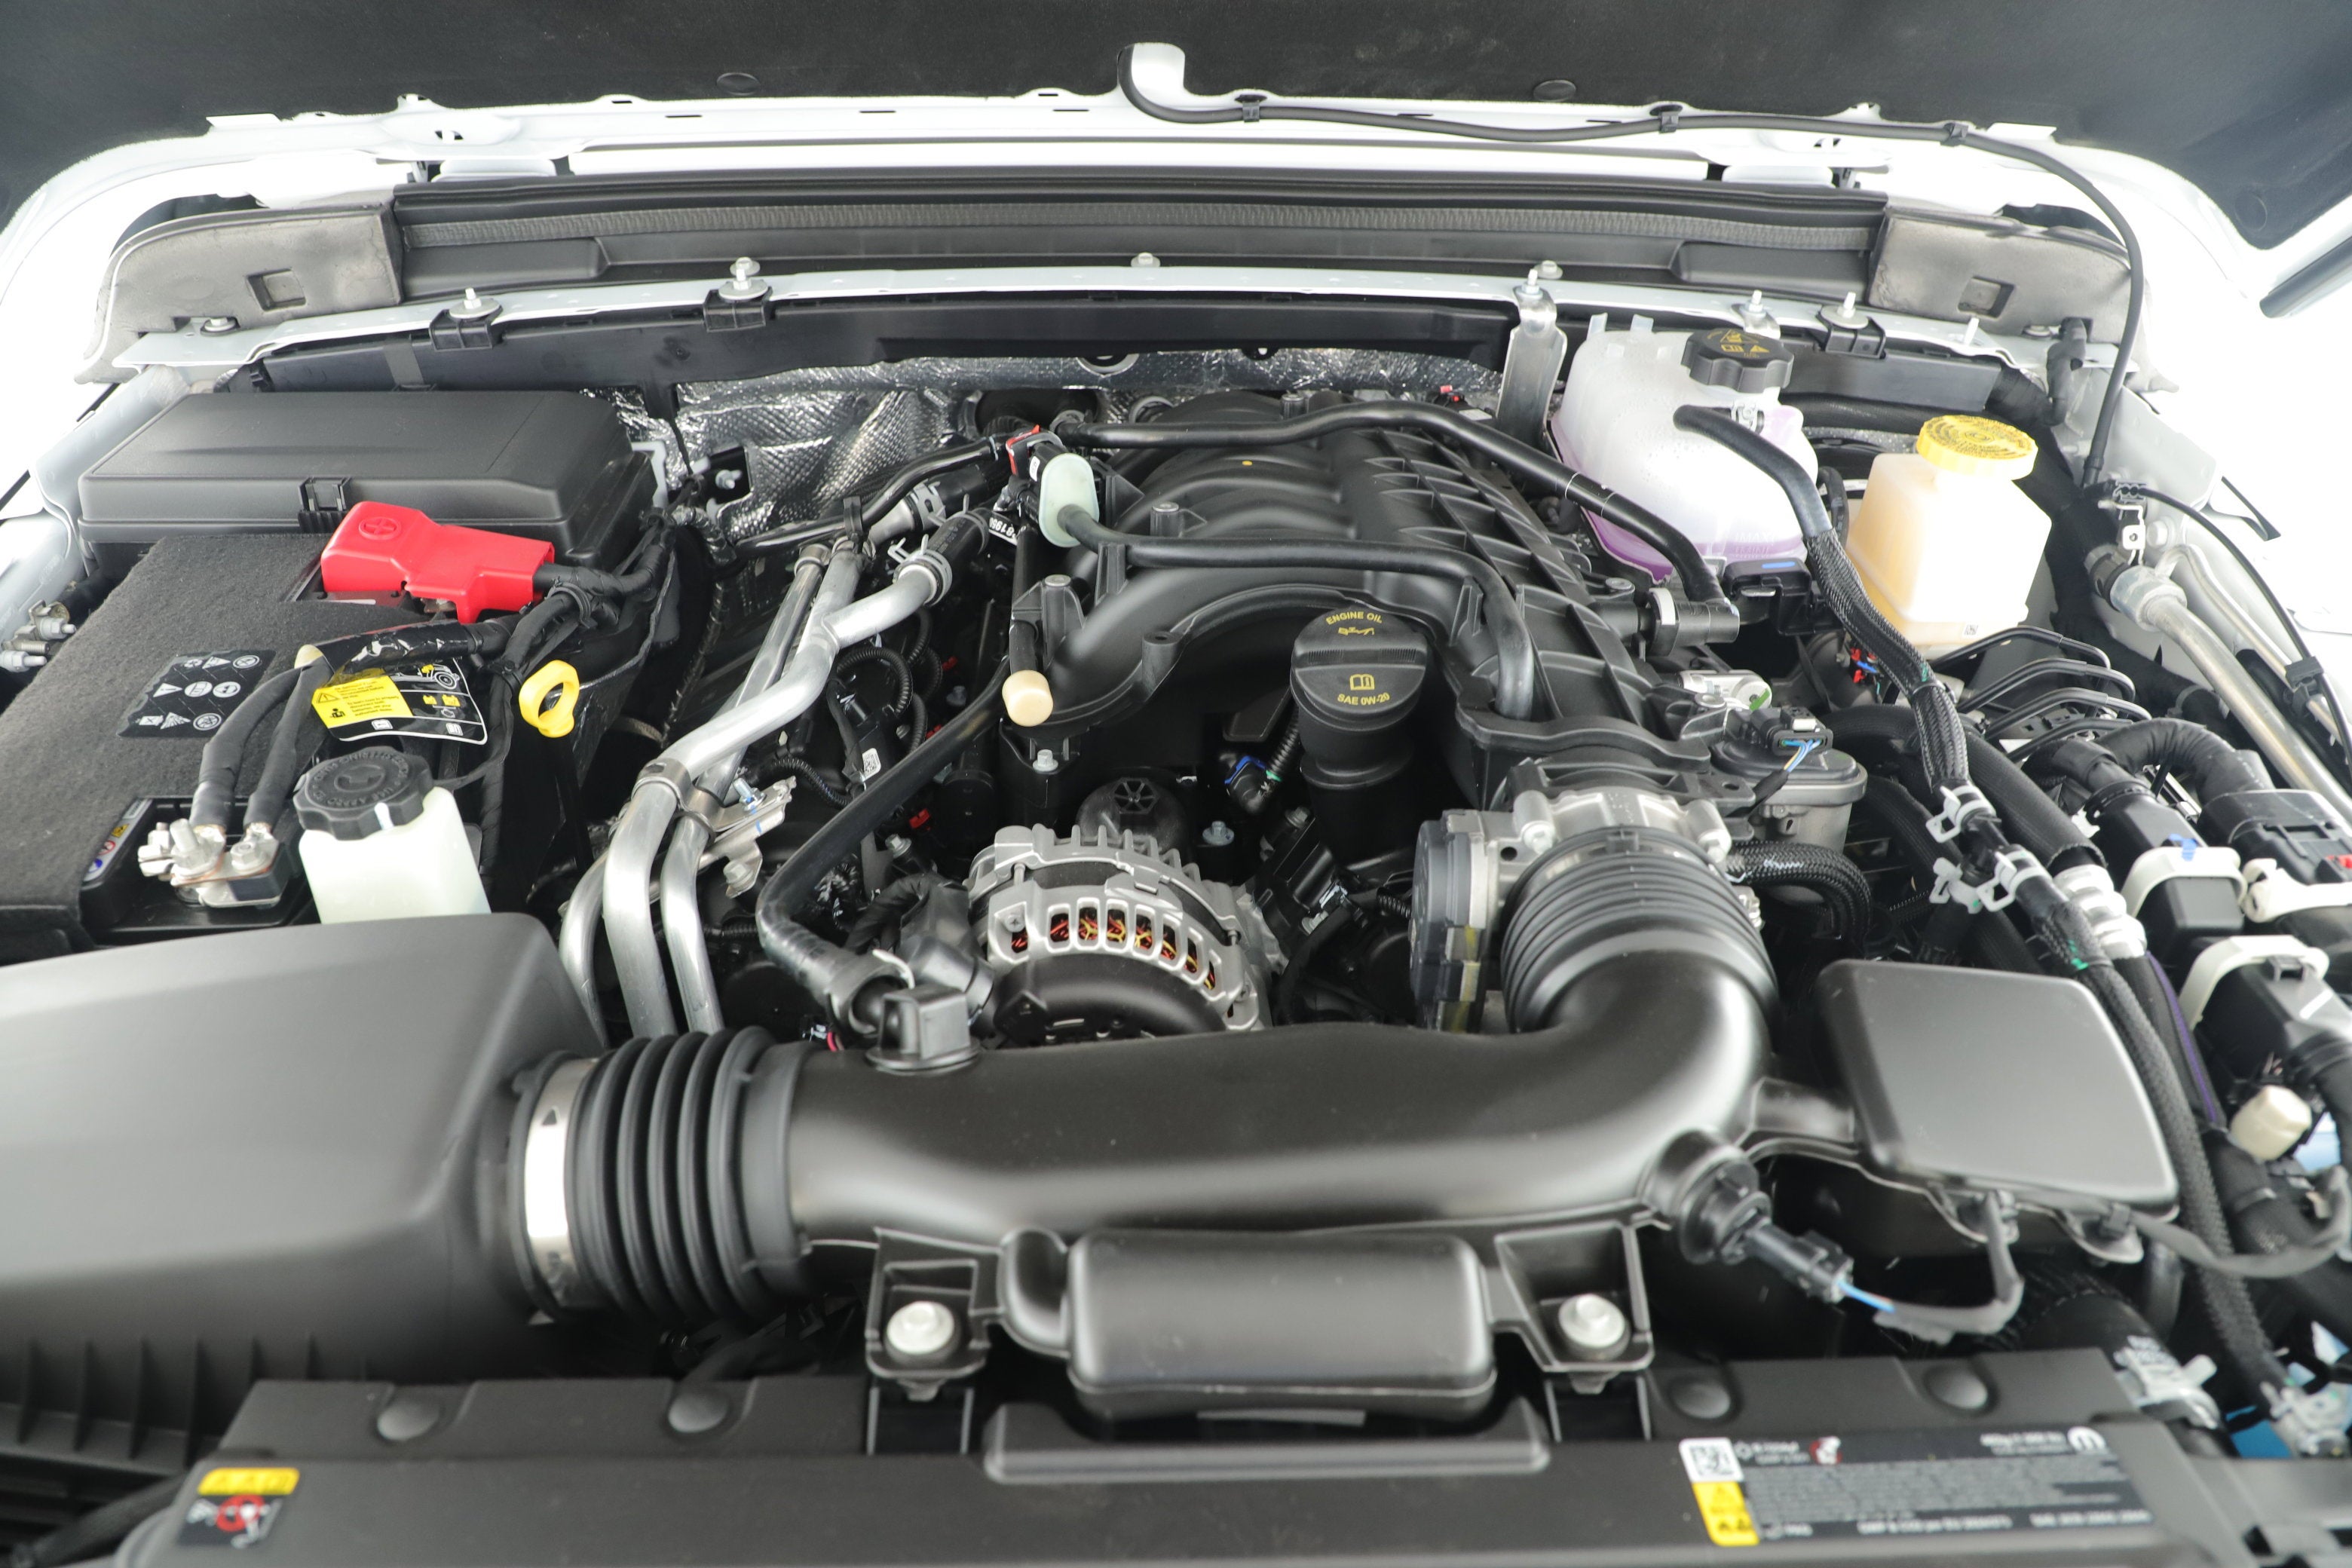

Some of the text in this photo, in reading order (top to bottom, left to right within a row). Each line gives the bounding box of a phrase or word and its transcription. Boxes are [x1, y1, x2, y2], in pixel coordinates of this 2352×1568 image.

[1326, 611, 1383, 625] ENGINE OIL
[1337, 692, 1390, 706] SAE 0W-20
